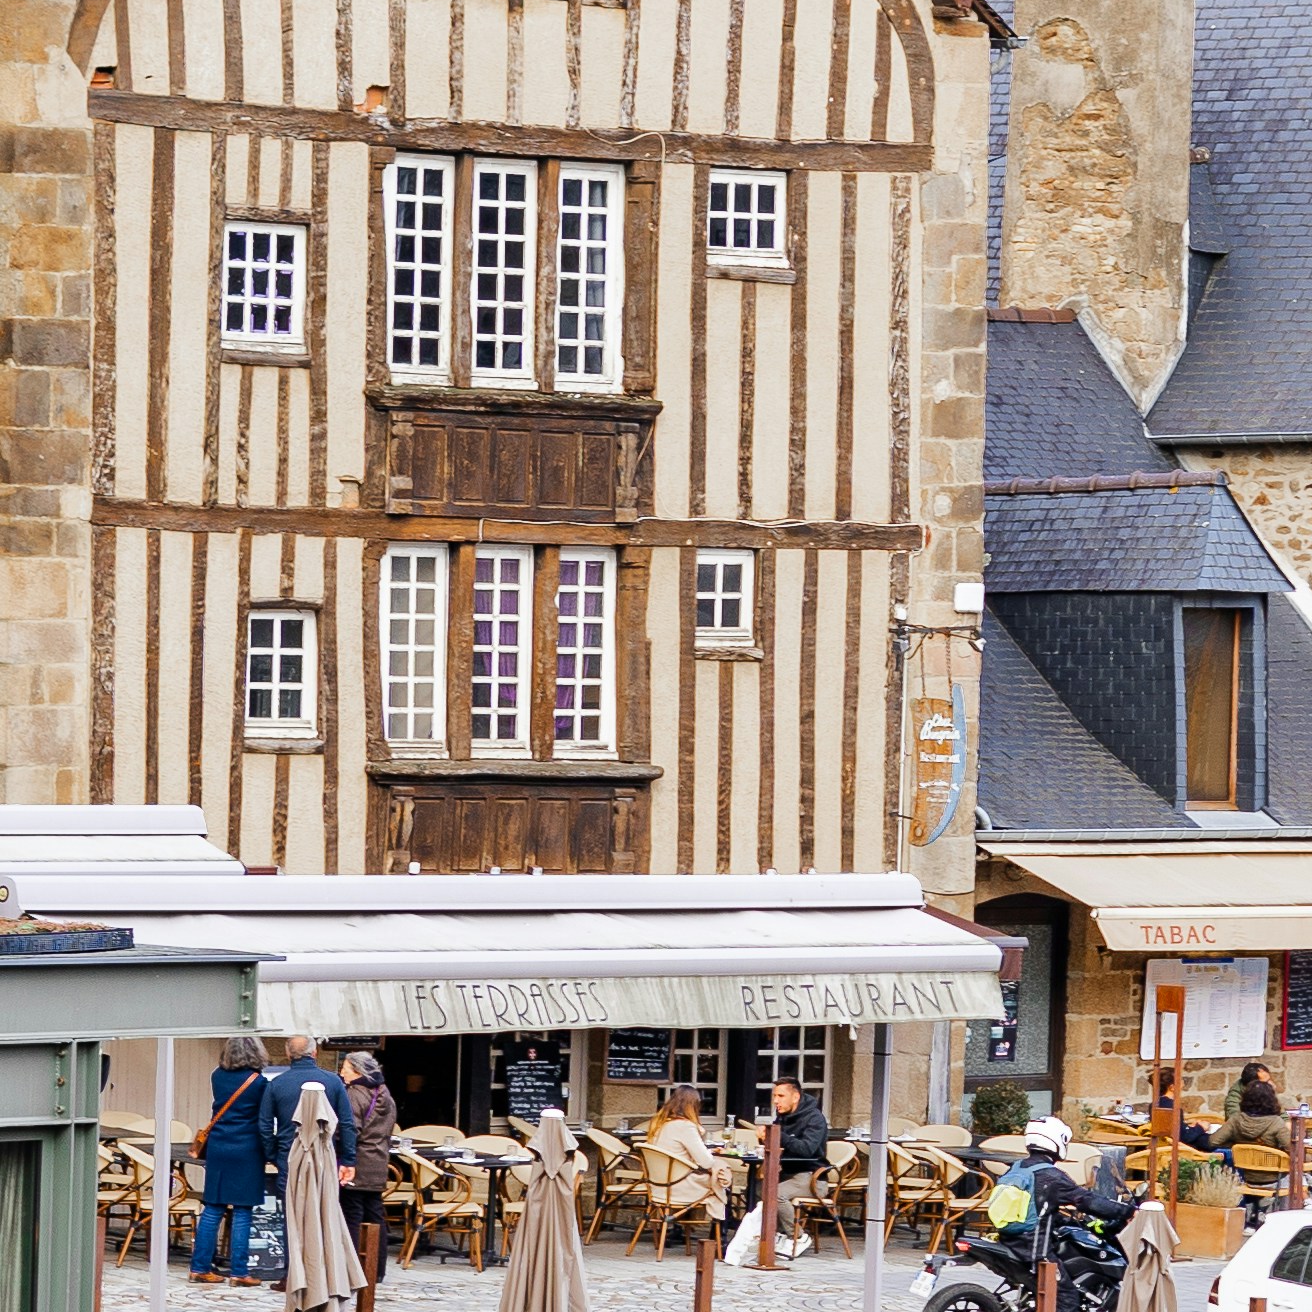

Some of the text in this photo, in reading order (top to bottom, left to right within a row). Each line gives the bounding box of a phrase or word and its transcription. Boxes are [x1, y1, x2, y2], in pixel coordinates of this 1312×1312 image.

[1140, 925, 1217, 945] TABAC
[402, 980, 960, 1030] LES TERRASSES RESTAURANT
